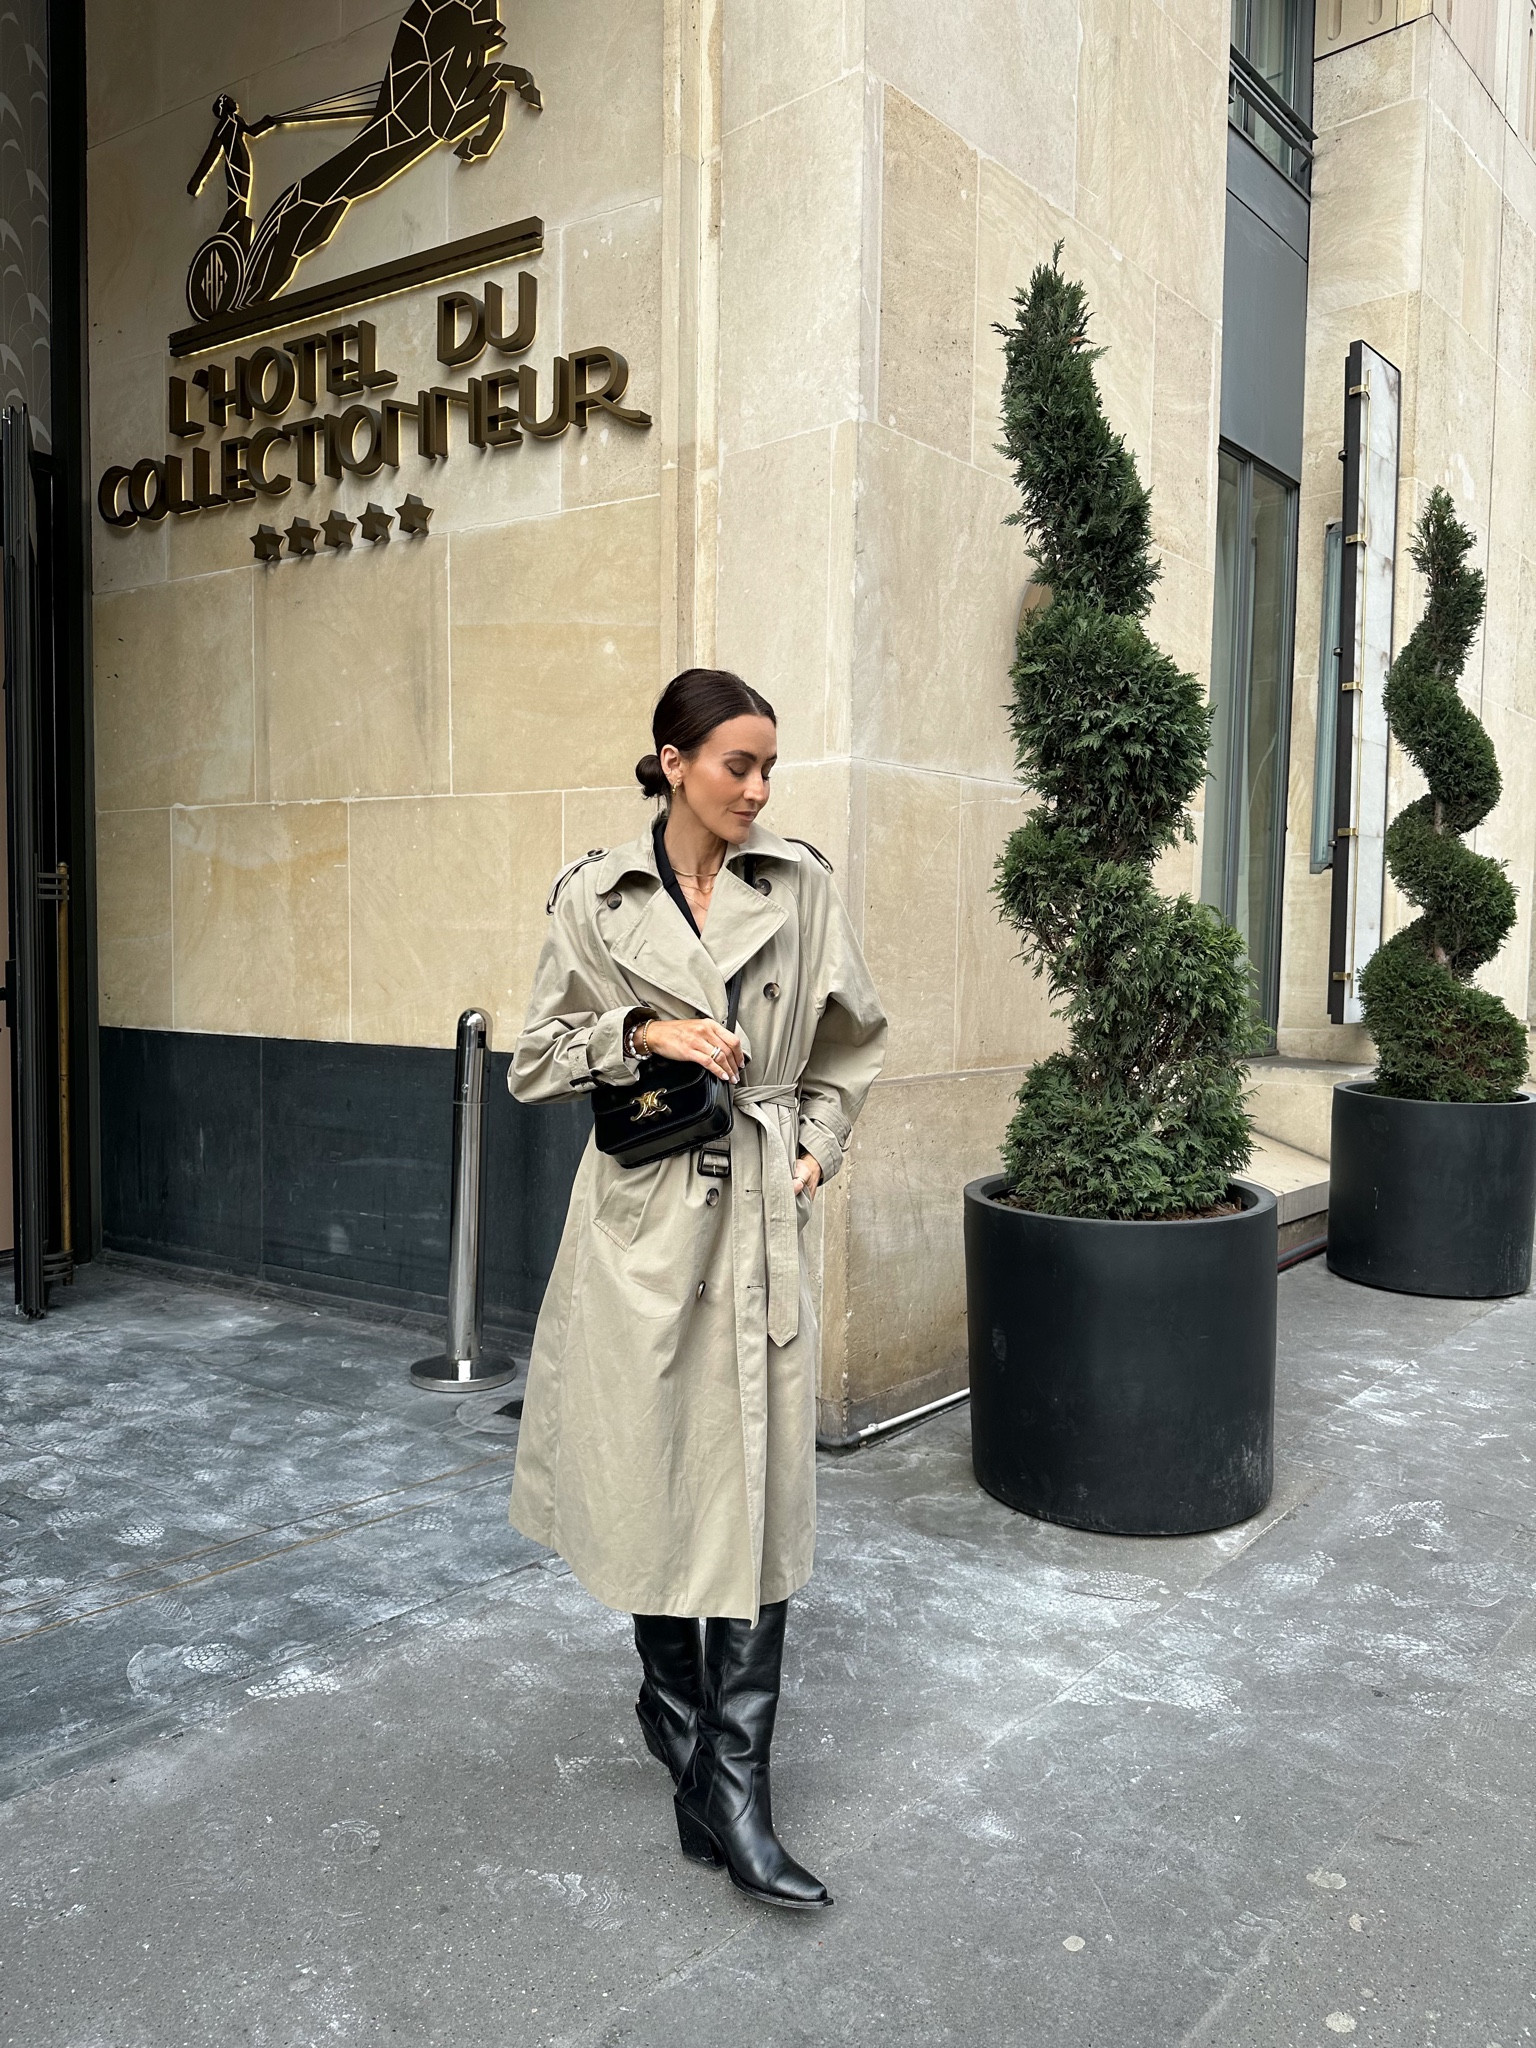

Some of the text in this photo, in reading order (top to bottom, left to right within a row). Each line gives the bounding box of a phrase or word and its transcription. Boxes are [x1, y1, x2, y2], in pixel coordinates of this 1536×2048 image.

[98, 346, 653, 528] COLLECTIONNEUR
[169, 271, 537, 438] L'HOTEL DU
